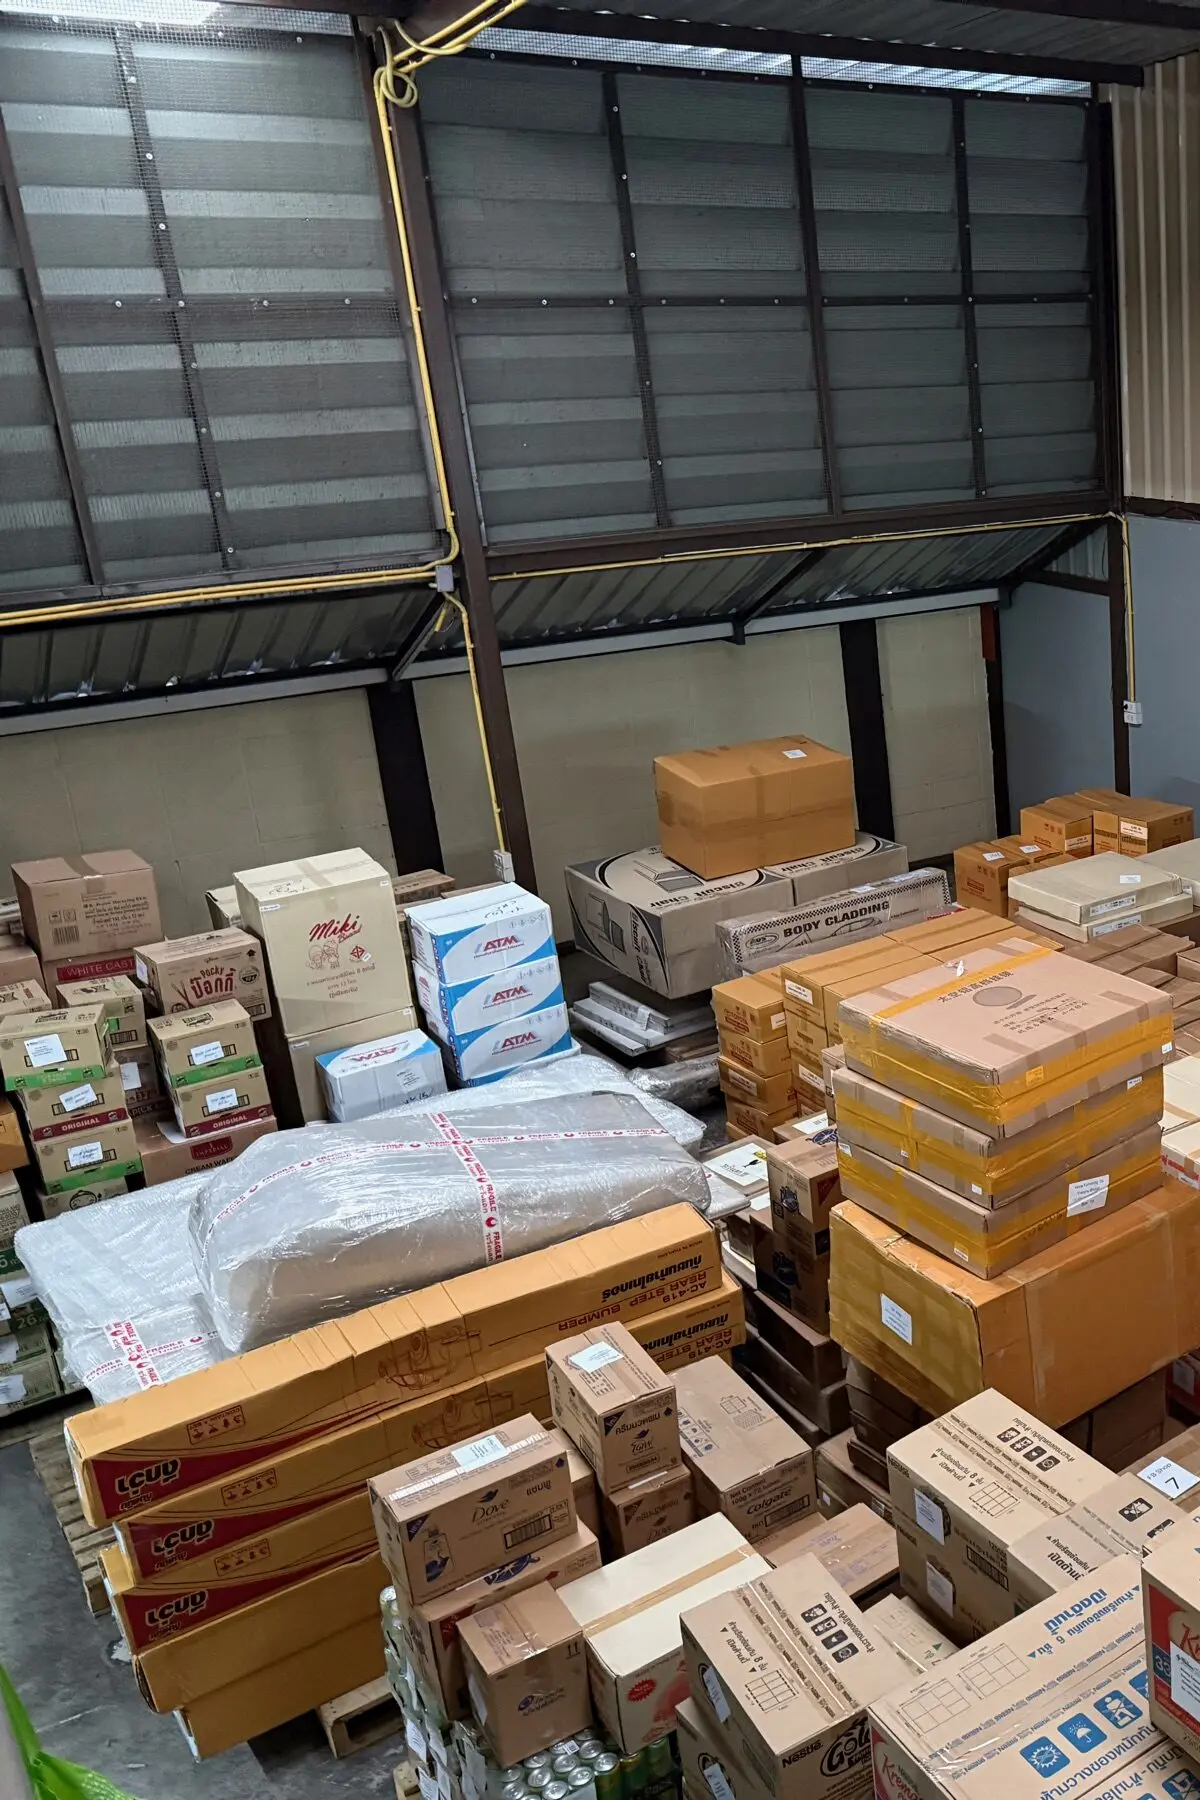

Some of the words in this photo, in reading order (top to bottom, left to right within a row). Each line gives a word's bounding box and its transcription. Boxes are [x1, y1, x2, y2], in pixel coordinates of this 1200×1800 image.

[694, 880, 746, 900] Biscuit
[649, 894, 690, 909] Chair
[309, 913, 361, 942] Miki
[783, 918, 822, 938] BODY
[824, 900, 891, 927] CLADDING
[483, 934, 520, 952] ATM
[201, 965, 225, 979] POCKY
[492, 983, 528, 1003] ATM
[501, 1031, 538, 1050] ATM
[351, 1046, 397, 1063] ATM
[61, 1117, 101, 1132] ORIGINAL
[212, 1113, 248, 1129] ORIGINAL
[185, 1162, 211, 1175] CREAM
[486, 1184, 497, 1212] FRAGILE
[493, 1231, 502, 1261] FRAGILE
[669, 1271, 707, 1292] REAR
[629, 1287, 668, 1308] STEP
[662, 1281, 707, 1304] AC-419
[558, 1304, 622, 1332] BUMPER
[145, 1340, 184, 1356] FRAGILE
[695, 1328, 732, 1349] REAR
[115, 1457, 181, 1498] ดีกว่า
[969, 1470, 978, 1479] 8
[1155, 1462, 1172, 1476] Shop
[1164, 1476, 1180, 1490] 7
[746, 1487, 793, 1515] Colgate
[471, 1501, 507, 1523] Dove
[754, 1656, 763, 1665] 8
